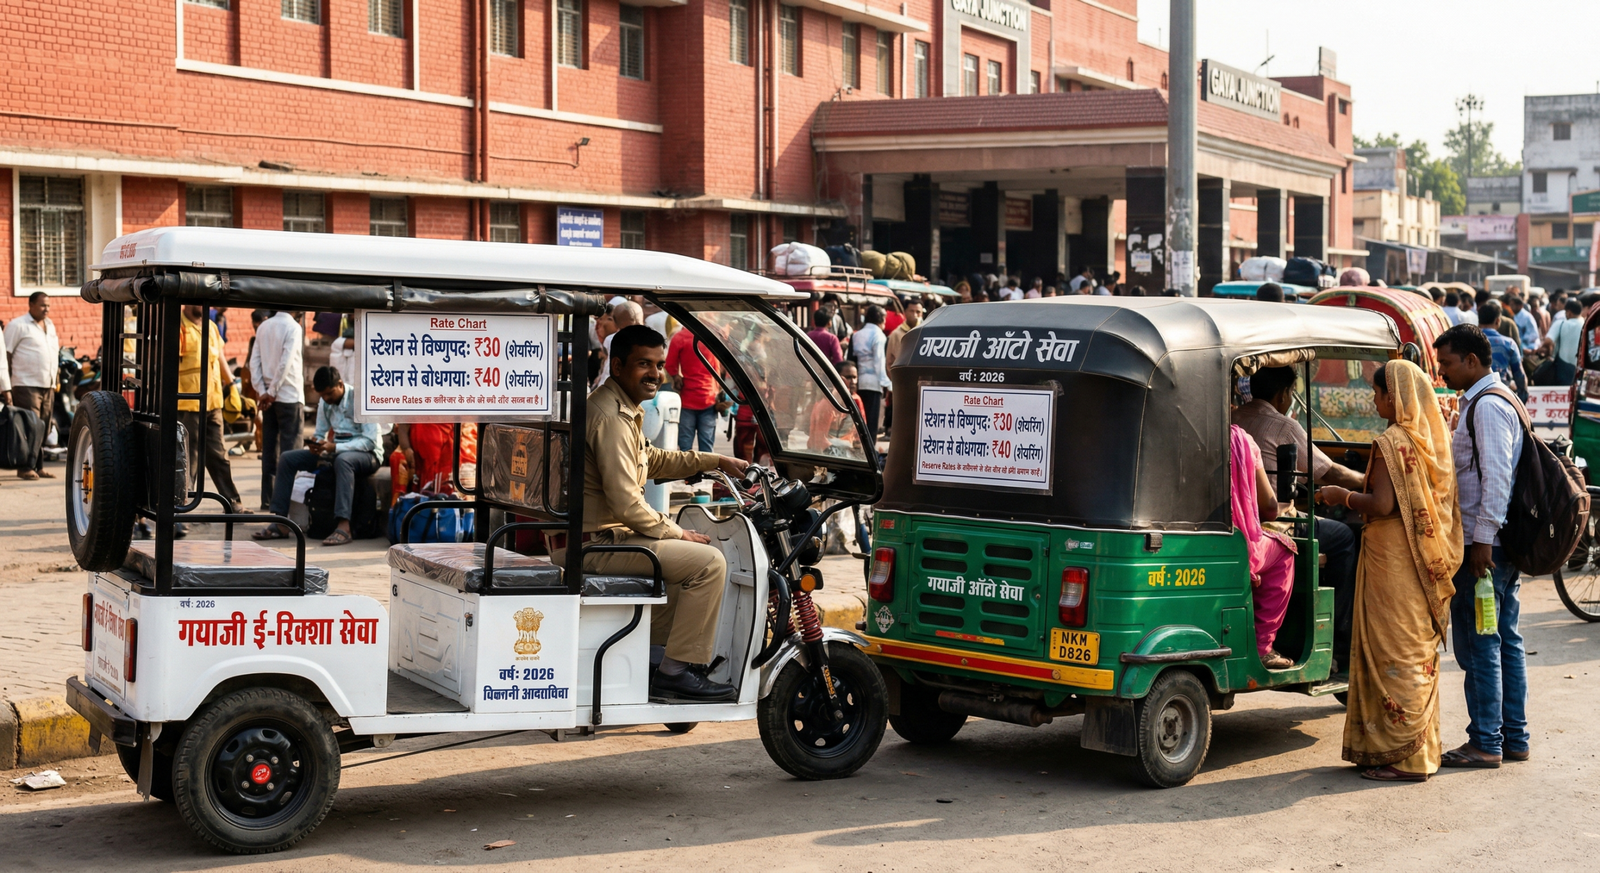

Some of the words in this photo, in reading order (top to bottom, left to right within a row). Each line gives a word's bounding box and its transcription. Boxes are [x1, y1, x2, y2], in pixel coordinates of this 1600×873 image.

[978, 0, 1027, 31] JUNCTION
[1209, 67, 1236, 100] GAYA
[1236, 77, 1280, 114] JUNCTION
[430, 317, 455, 329] Rate
[457, 317, 487, 329] Chart
[370, 333, 404, 356] स्टेशन
[407, 333, 418, 356] से
[474, 336, 500, 357] ₹30
[505, 340, 543, 360] (शेयरिंग)
[918, 329, 981, 359] गयाजी
[1035, 331, 1080, 363] सेवा
[370, 364, 404, 387] स्टेशन
[407, 364, 418, 387] से
[474, 367, 500, 387] ₹40
[505, 370, 543, 390] (शेयरिंग)
[979, 372, 1005, 383] 2026
[370, 395, 400, 404] Reserve
[402, 395, 423, 404] Rates
[964, 395, 981, 405] Rate
[982, 396, 1004, 406] Chart
[924, 408, 946, 428] स्टेशन
[948, 409, 956, 428] से
[993, 413, 1012, 431] ₹30
[1015, 416, 1045, 436] (शेयरिंग)
[923, 435, 944, 455] स्टेशन
[946, 436, 954, 455] से
[992, 440, 1011, 459] ₹40
[1013, 444, 1043, 463] (शेयरिंग)
[921, 461, 941, 470] Reserve
[1175, 567, 1206, 587] 2026
[927, 575, 966, 594] गयाजी
[968, 578, 997, 598] ऑटो
[999, 580, 1025, 601] सेवा
[196, 600, 216, 608] 2026
[178, 611, 247, 647] गयाजी
[253, 610, 334, 650] ई-रिक्शा
[339, 609, 379, 645] सेवा
[1061, 631, 1087, 646] NKM
[1059, 645, 1091, 661] D826
[523, 668, 554, 680] 2026
